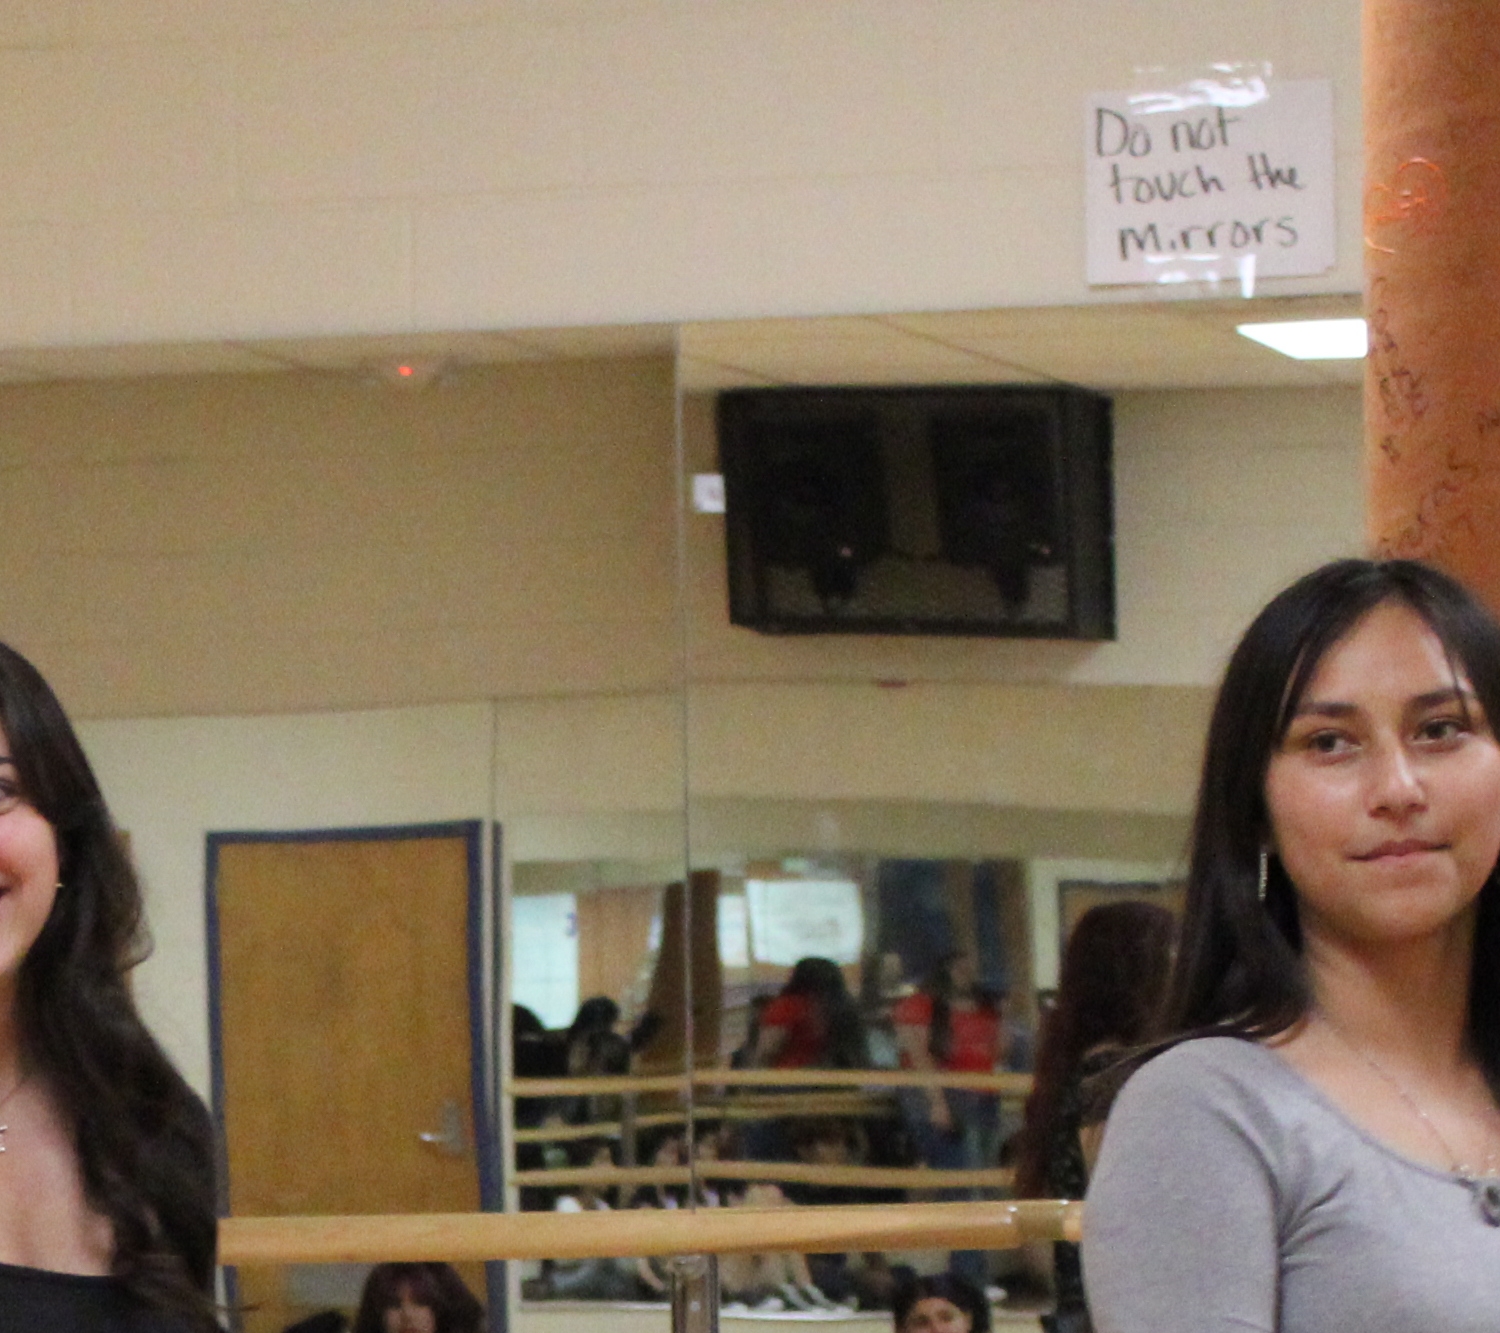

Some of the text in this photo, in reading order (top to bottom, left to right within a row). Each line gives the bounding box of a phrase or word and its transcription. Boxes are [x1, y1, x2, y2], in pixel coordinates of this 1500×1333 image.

[1096, 106, 1240, 157] Do not
[1110, 153, 1306, 204] touch the
